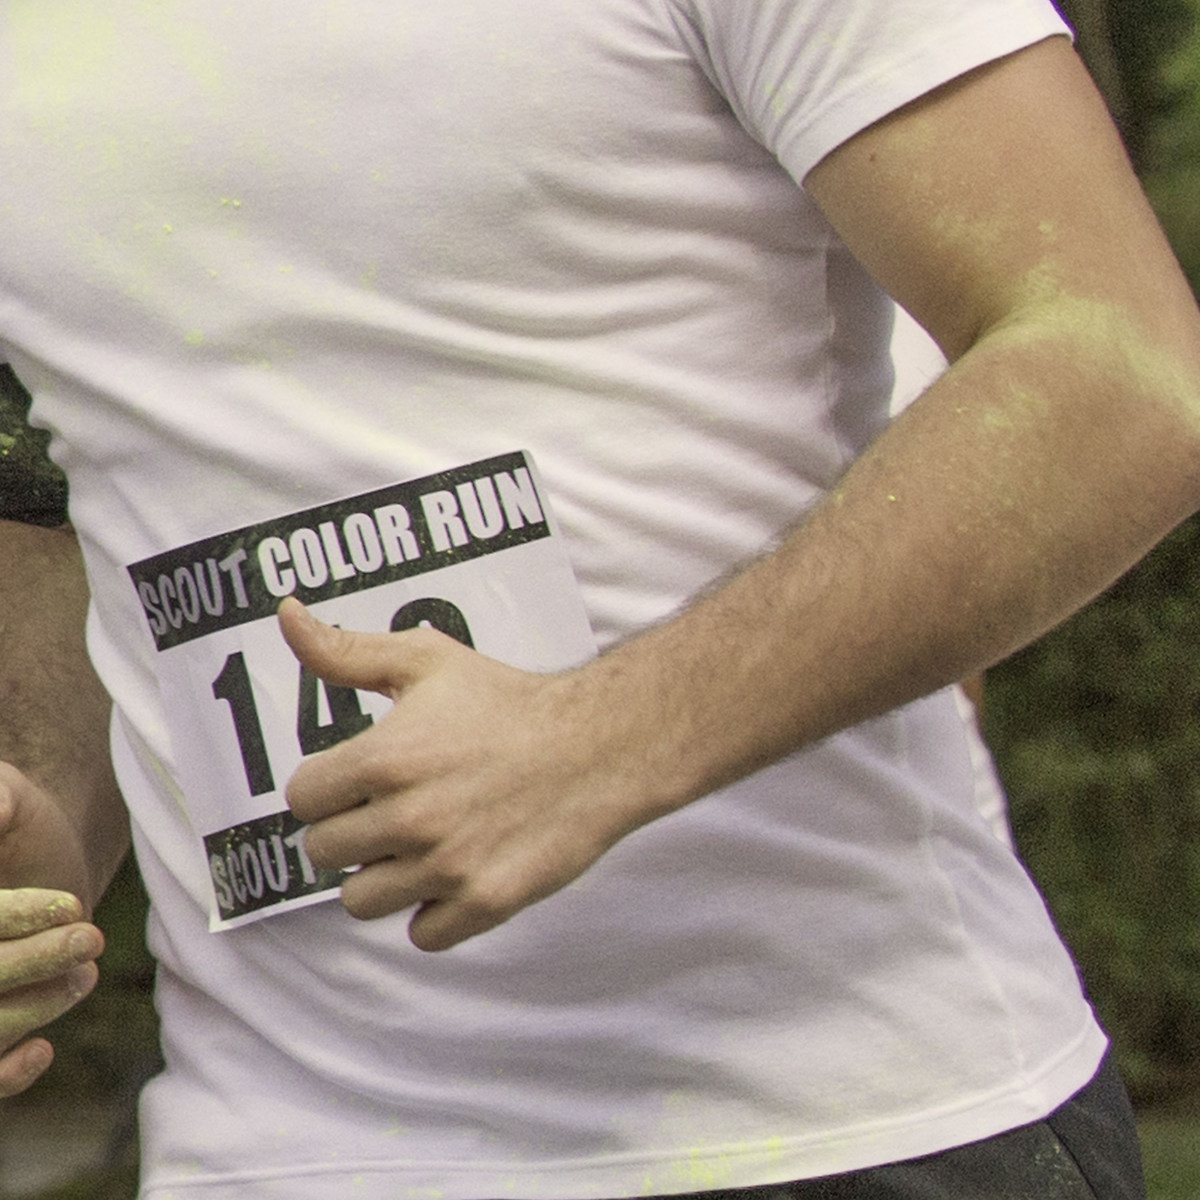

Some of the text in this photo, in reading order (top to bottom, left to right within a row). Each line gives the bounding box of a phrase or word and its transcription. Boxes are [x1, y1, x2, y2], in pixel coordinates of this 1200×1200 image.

[138, 467, 545, 636] SCOUT COLOR RUN
[211, 597, 478, 797] 14
